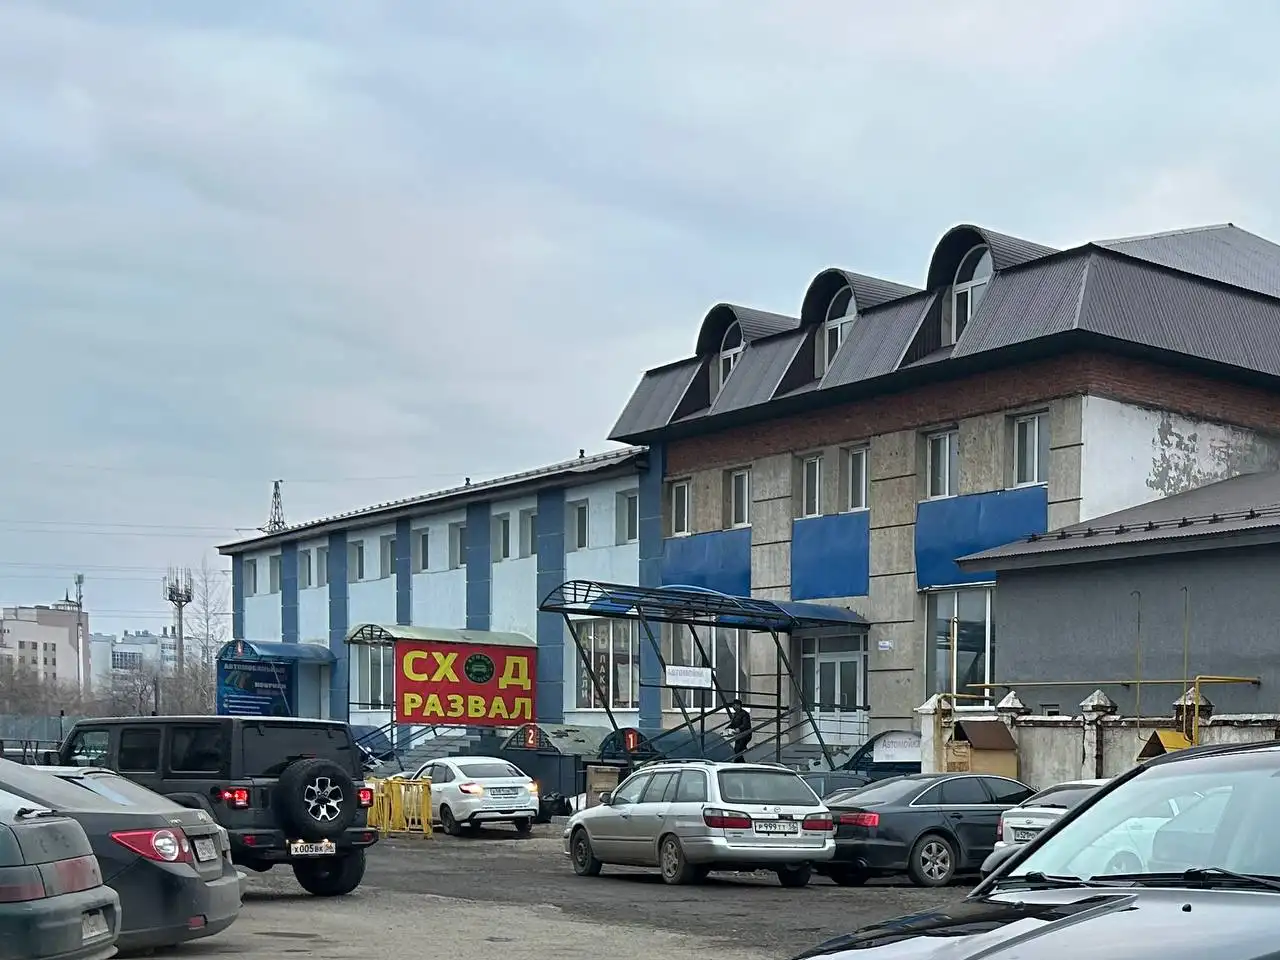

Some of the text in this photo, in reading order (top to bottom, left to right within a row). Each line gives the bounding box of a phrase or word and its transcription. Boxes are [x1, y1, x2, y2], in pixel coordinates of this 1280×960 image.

[403, 692, 532, 720] РАЗВАЛ
[528, 729, 534, 744] 2
[628, 732, 634, 749] 1
